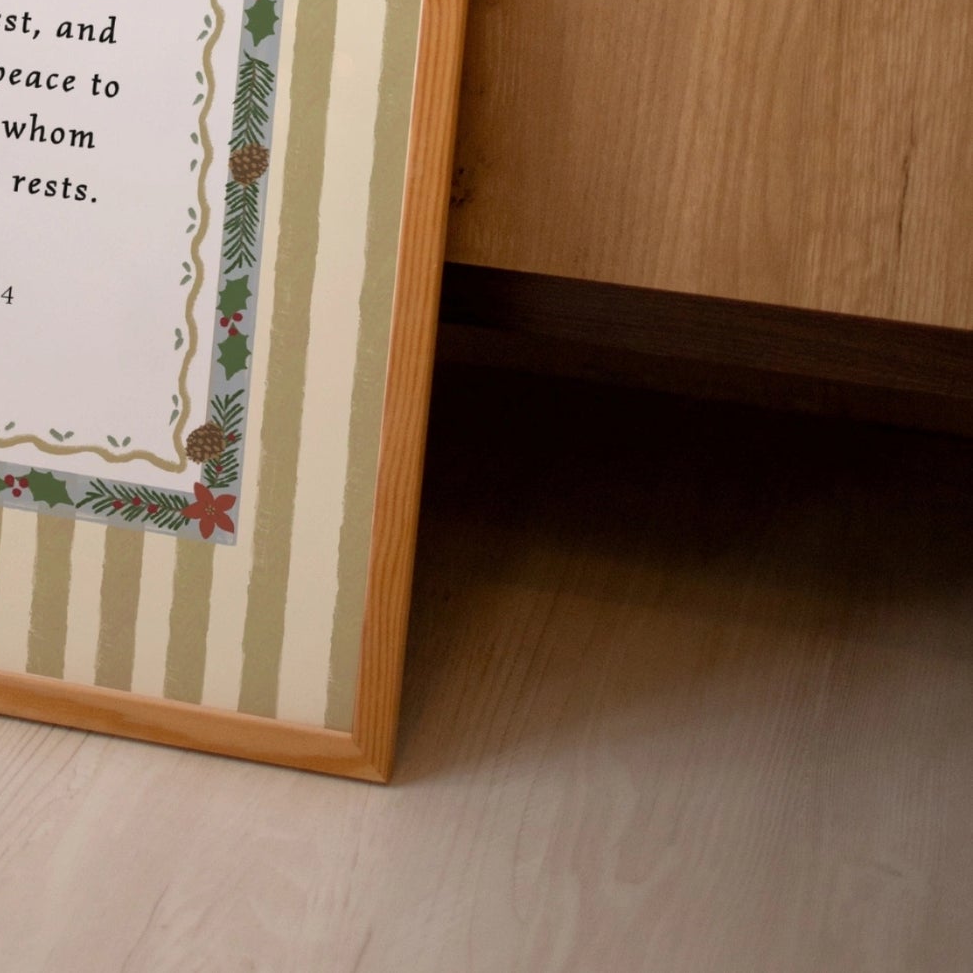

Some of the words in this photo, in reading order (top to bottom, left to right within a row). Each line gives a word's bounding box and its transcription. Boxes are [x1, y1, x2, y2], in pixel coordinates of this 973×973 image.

[56, 15, 117, 44] and
[91, 73, 120, 98] to
[1, 113, 95, 149] whom
[12, 174, 97, 203] rests.
